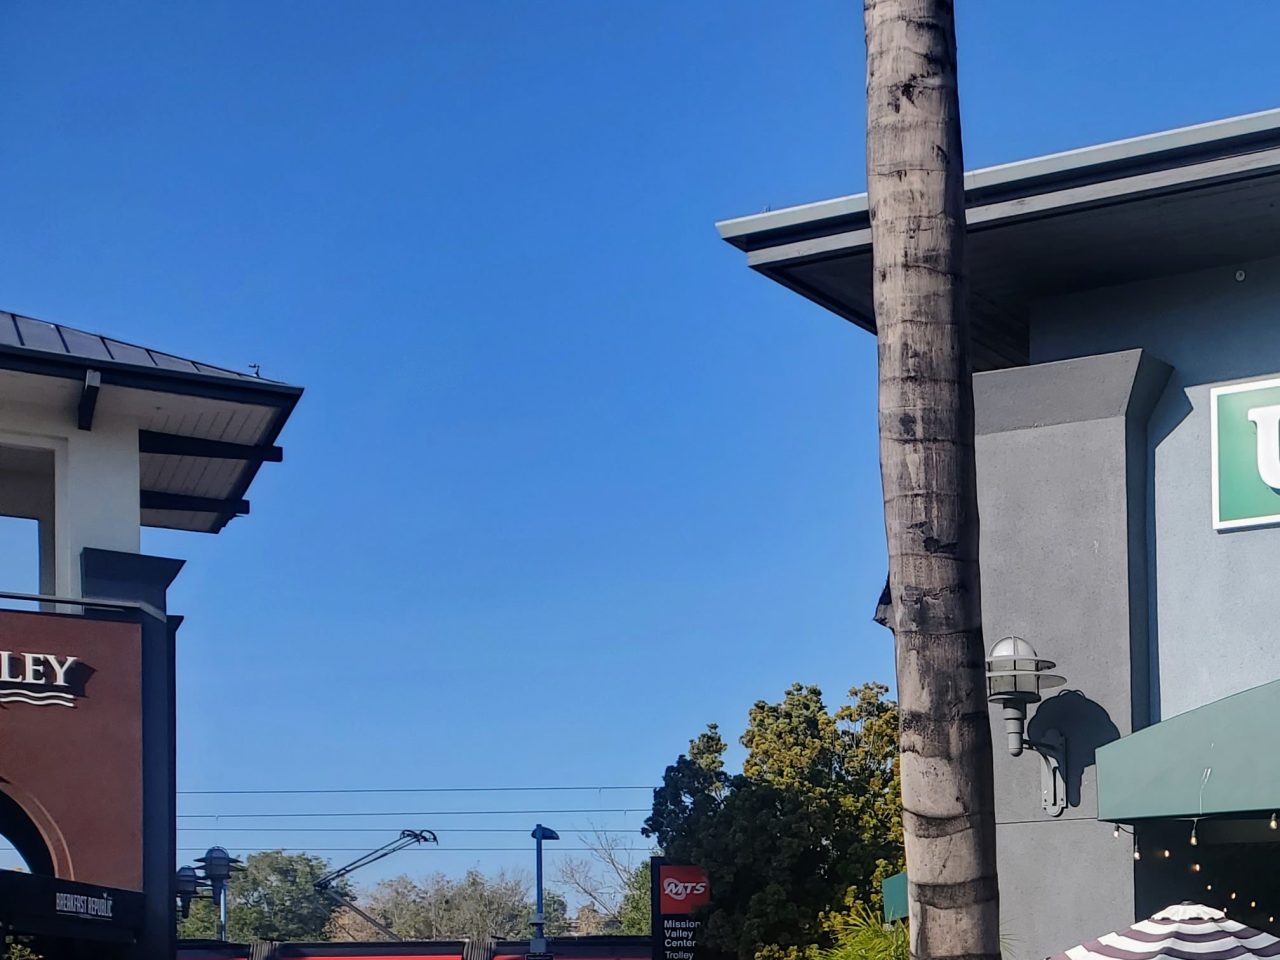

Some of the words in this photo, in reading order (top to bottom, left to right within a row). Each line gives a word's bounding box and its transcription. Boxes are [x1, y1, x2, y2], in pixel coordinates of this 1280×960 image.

[664, 882, 706, 895] MTS
[56, 892, 87, 912] BREAKFAST
[88, 896, 112, 917] REPUBLIC
[664, 929, 693, 940] Valley
[664, 939, 697, 948] Center
[665, 951, 694, 960] Trolley
